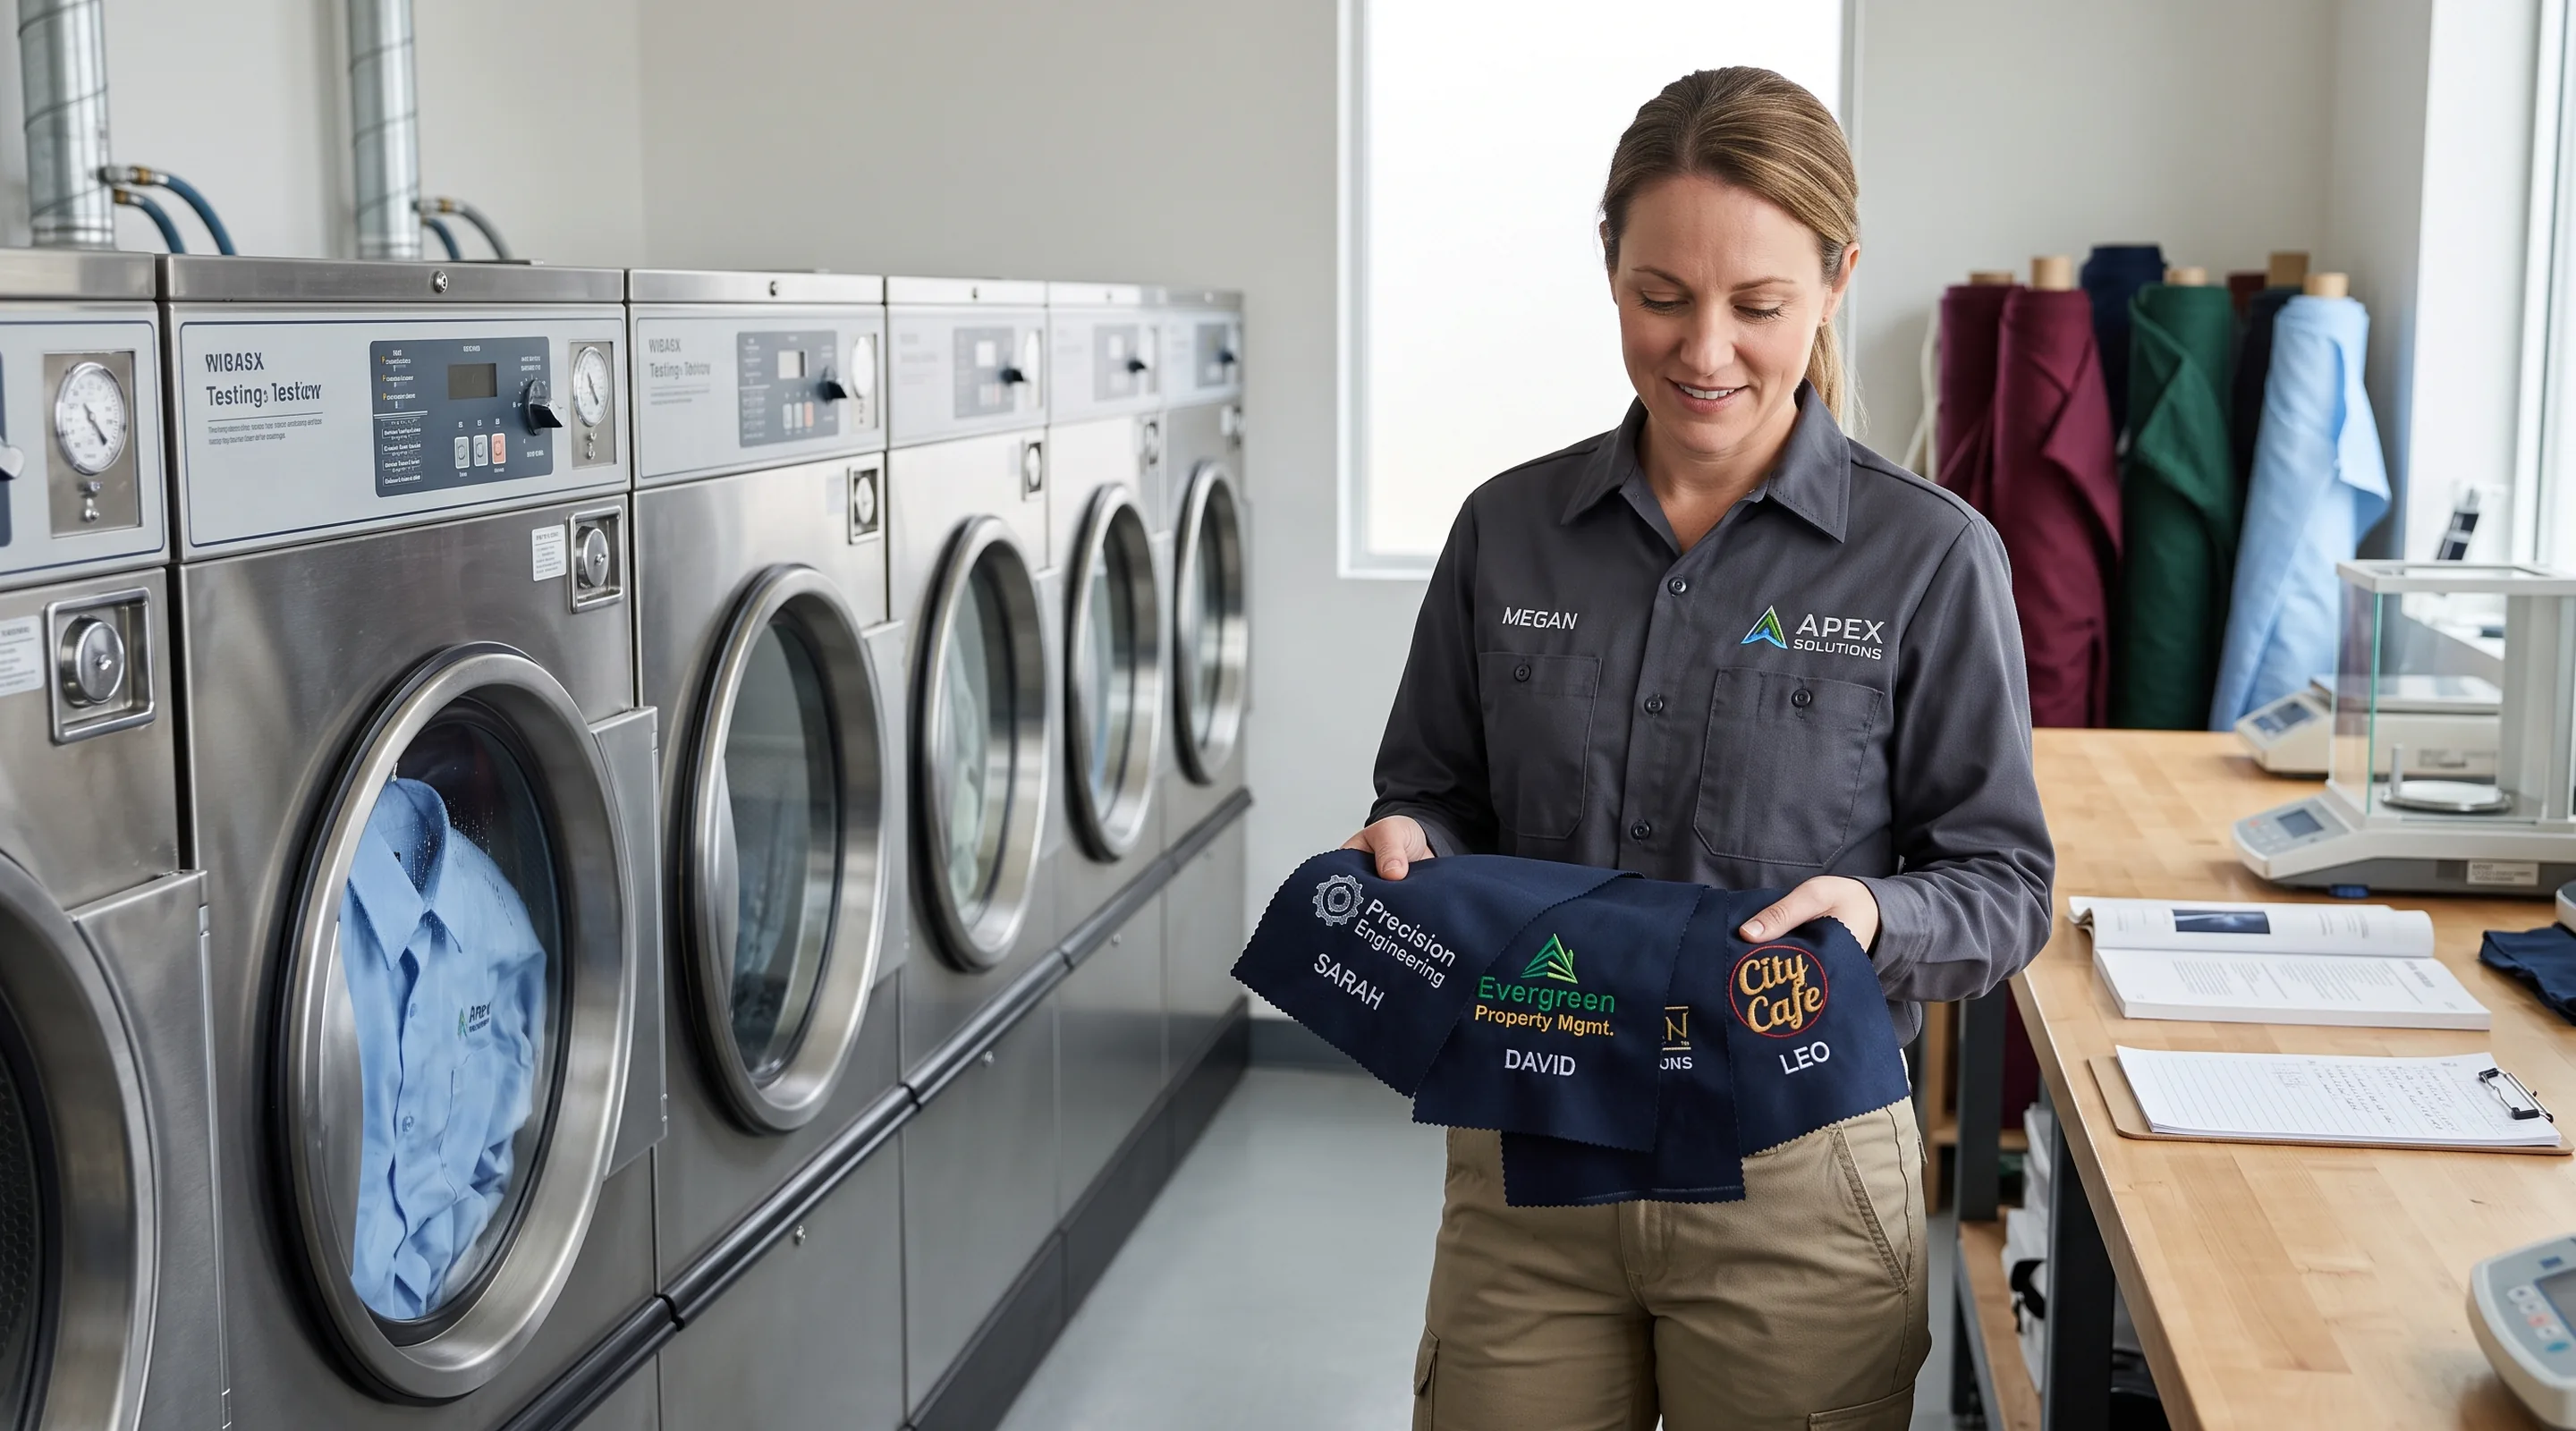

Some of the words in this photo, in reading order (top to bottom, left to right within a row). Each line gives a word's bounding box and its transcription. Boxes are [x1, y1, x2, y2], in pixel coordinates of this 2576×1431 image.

[1502, 606, 1578, 630] MEGAN
[1795, 614, 1885, 644] APEX
[1792, 639, 1883, 660] SOLUTIONS
[1365, 899, 1456, 968] Precision
[1354, 919, 1445, 989] Engineering
[1314, 953, 1385, 1011] SARAH
[1738, 953, 1809, 995] City
[1478, 976, 1615, 1013] Evergreen
[1748, 986, 1823, 1032] Cafe
[1474, 1004, 1553, 1032] Property
[1557, 1013, 1614, 1037] Mgmt.
[1504, 1048, 1576, 1077] DAVID
[1778, 1041, 1830, 1074] LEO
